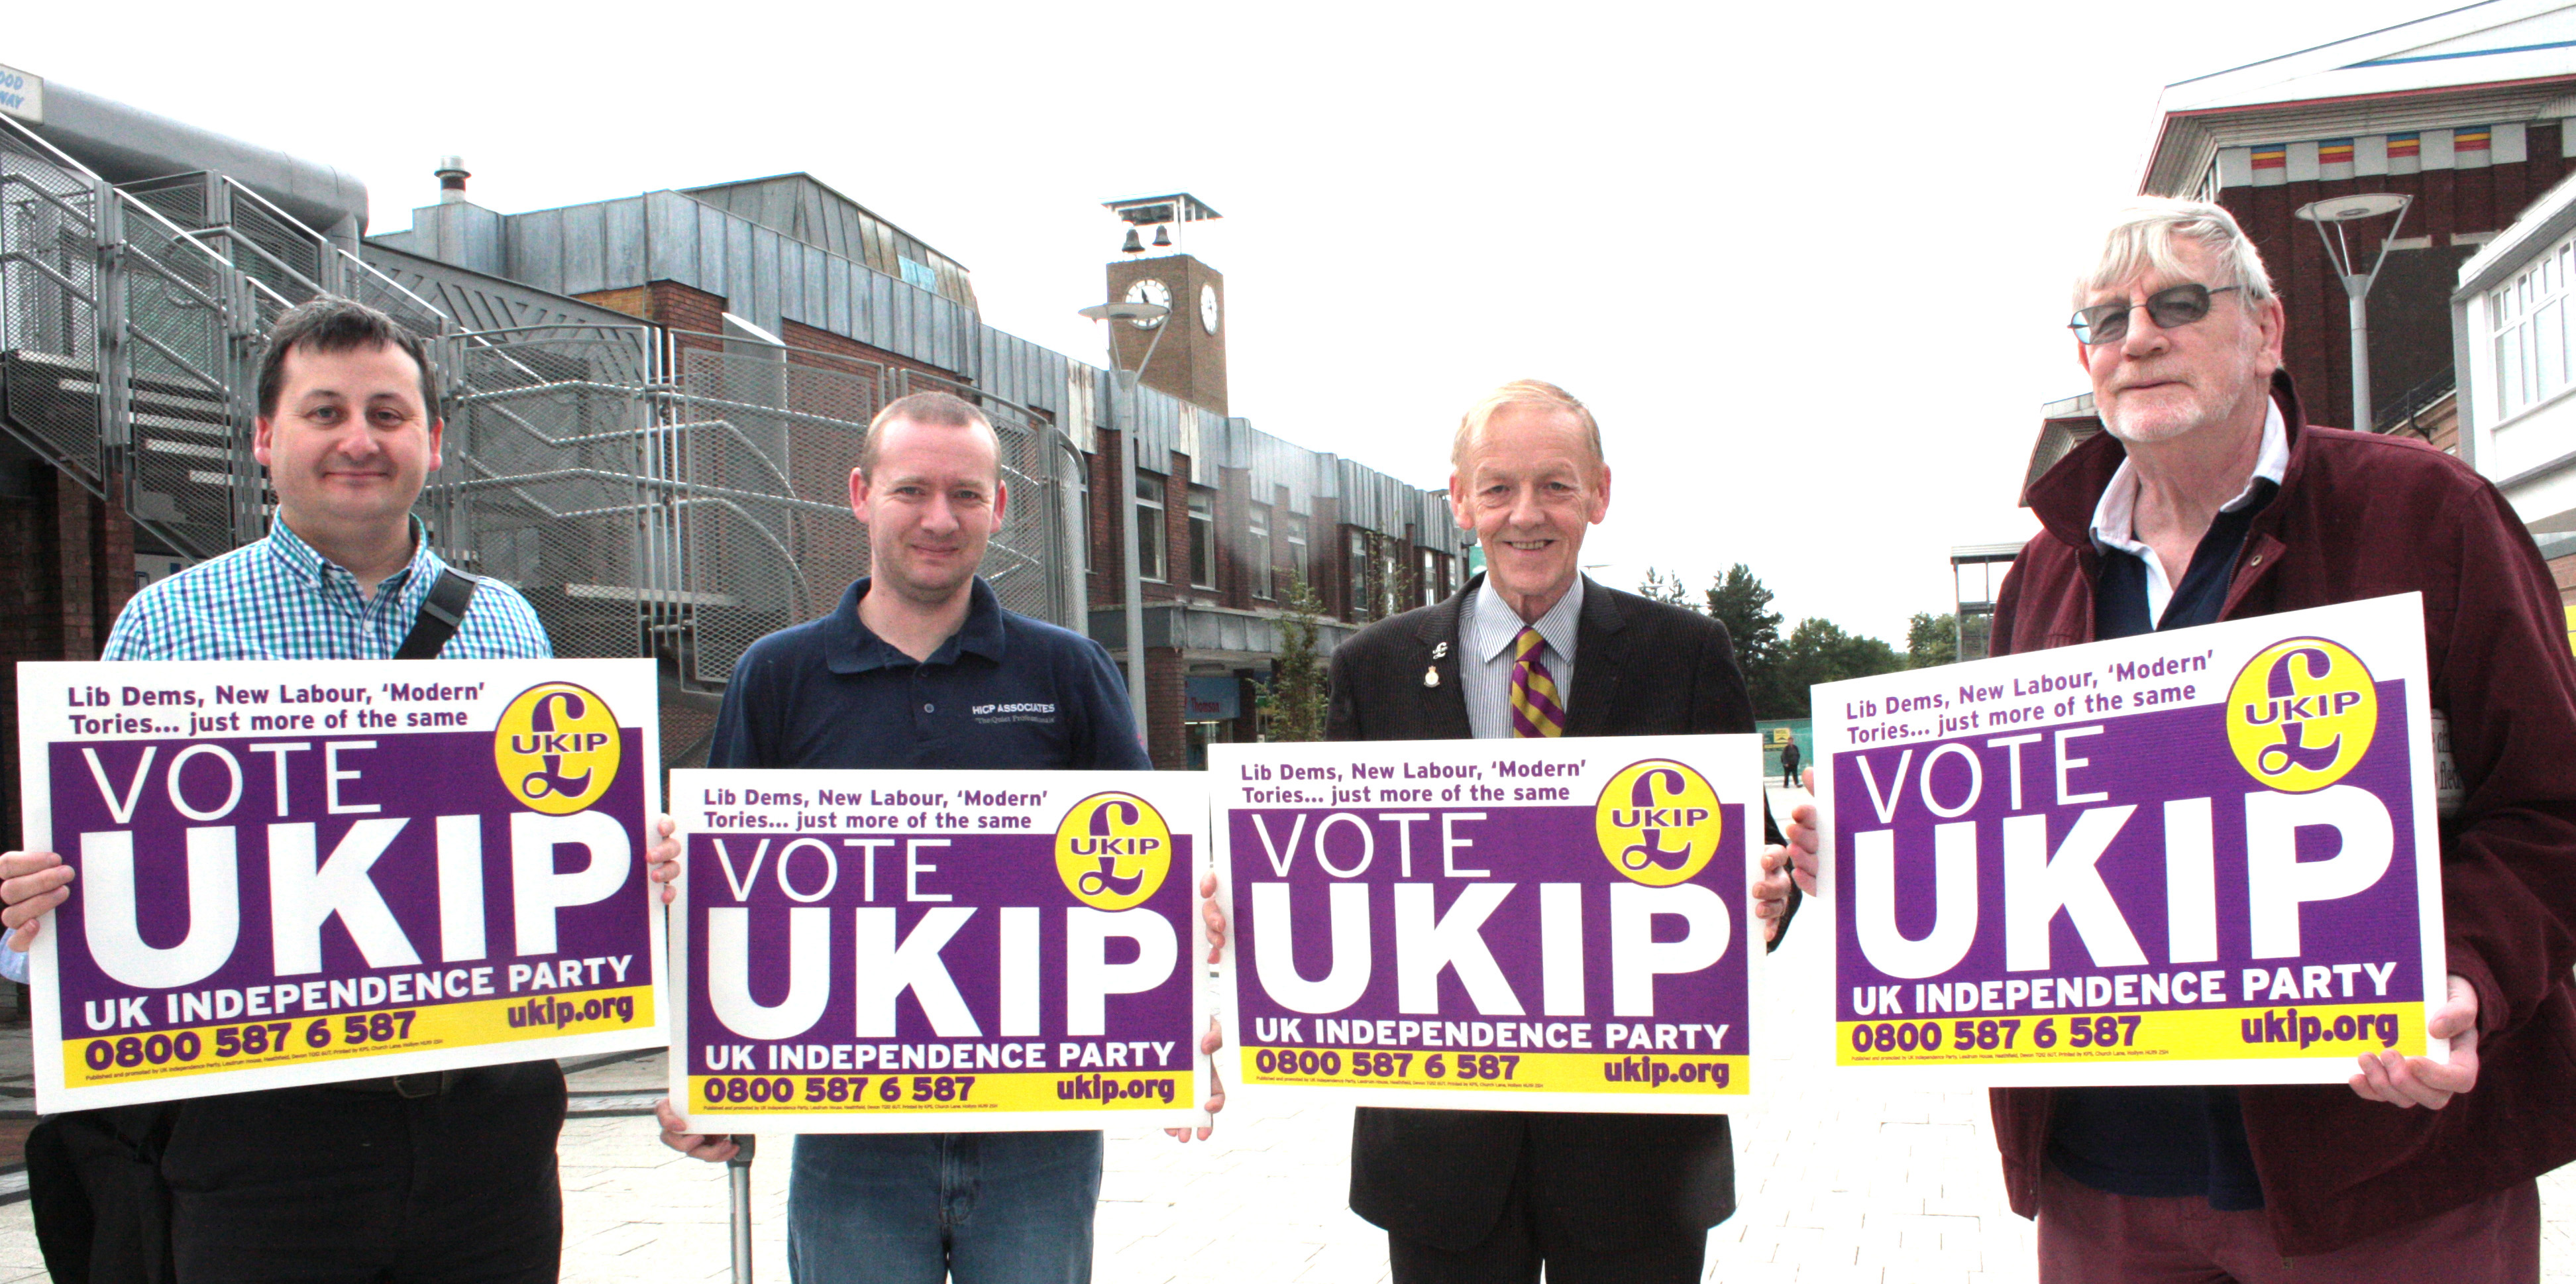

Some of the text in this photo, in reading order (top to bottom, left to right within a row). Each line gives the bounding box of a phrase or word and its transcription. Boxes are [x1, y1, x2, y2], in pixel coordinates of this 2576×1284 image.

[68, 686, 110, 708] Lib
[122, 686, 204, 708] Dems,
[216, 685, 269, 705] New
[280, 684, 372, 706] Labour,
[997, 702, 1055, 714] ASSOCIATES
[1847, 700, 1876, 720] Lib
[1886, 694, 1949, 715] Dems,
[1959, 684, 2003, 704] New
[2013, 671, 2097, 697] Labour,
[2245, 691, 2359, 725] UKIP
[68, 709, 468, 736] Tories... just more of the same
[1847, 684, 2195, 744] Tories... just more of the same
[512, 733, 608, 754] UKIP
[81, 740, 381, 824] VOTE
[1241, 763, 1271, 781] Lib
[1280, 764, 1342, 782] Dems,
[1352, 763, 1394, 780] New
[1403, 762, 1481, 780] Labour,
[1855, 724, 2108, 824] VOTE
[704, 788, 735, 806] Lib
[745, 789, 808, 808] Dems,
[819, 789, 861, 806] New
[871, 789, 947, 809] Labour,
[1242, 784, 1570, 807] Tories... just more of the same
[704, 810, 1031, 831] Tories... just more of the same
[1612, 808, 1708, 828] UKIP
[1071, 838, 1159, 855] UKIP
[1251, 812, 1491, 879] VOTE
[712, 837, 953, 903] VOTE
[1854, 781, 2394, 980] UKIP
[80, 806, 631, 989] UKIP
[1251, 879, 1731, 1018] UKIP
[708, 904, 1177, 1040] UKIP
[1852, 961, 2396, 1016] UK INDEPENDENCE PARTY
[85, 954, 632, 1031] UK INDEPENDENCE PARTY
[507, 995, 633, 1030] ukip.org
[2241, 1008, 2398, 1050] ukip.org
[85, 1010, 416, 1071] 0800 587 6 587
[1255, 1017, 1729, 1050] UK INDEPENDENCE PARTY
[1851, 1014, 2141, 1053] 0800 587 6 587
[706, 1041, 1175, 1071] UK INDEPENDENCE PARTY
[1256, 1049, 1520, 1080] 0800 587 6 587
[1603, 1055, 1730, 1089] ukip.org
[704, 1075, 975, 1104] 0800 587 6 587
[1057, 1073, 1175, 1105] ukip.org
